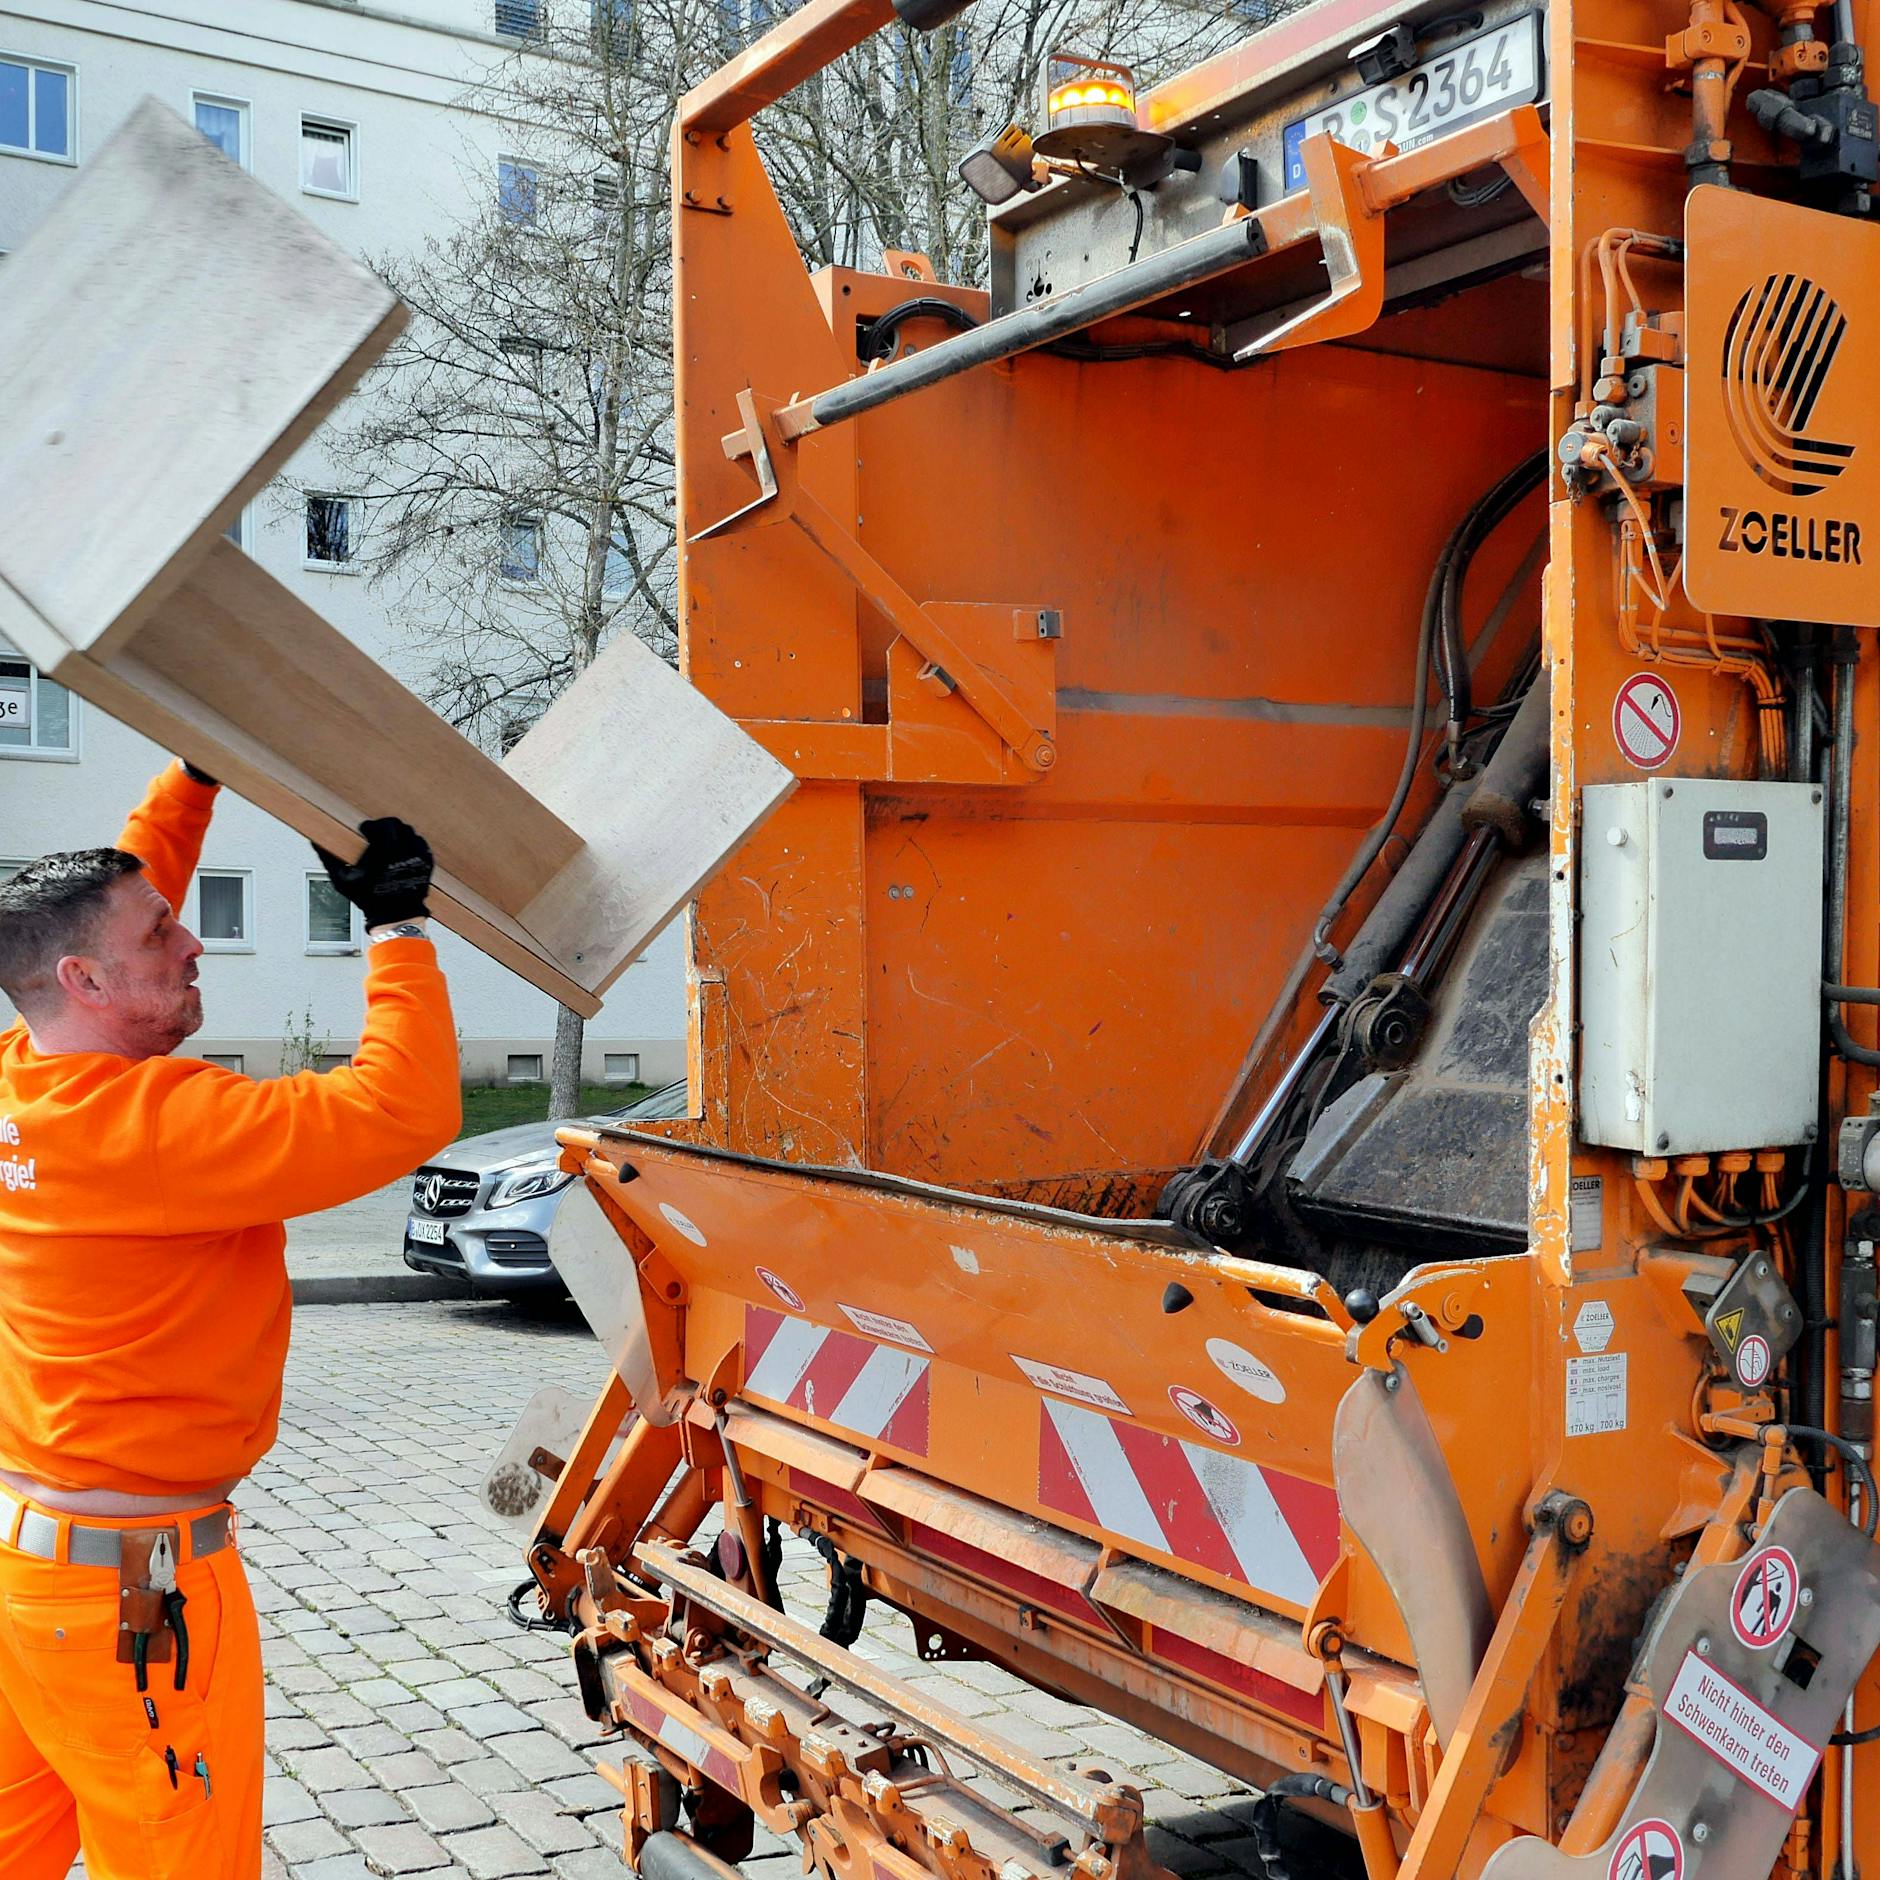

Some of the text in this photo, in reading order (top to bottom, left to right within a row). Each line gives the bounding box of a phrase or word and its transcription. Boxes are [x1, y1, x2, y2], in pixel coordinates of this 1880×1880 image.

[1374, 86, 1399, 142] S
[1409, 34, 1513, 131] 2364
[1719, 506, 1863, 565] ZOELLER
[1600, 1420, 1614, 1429] 700
[1678, 1694, 1789, 1794] Schwenkarm treten
[1697, 1675, 1791, 1761] Nicht hinter den
